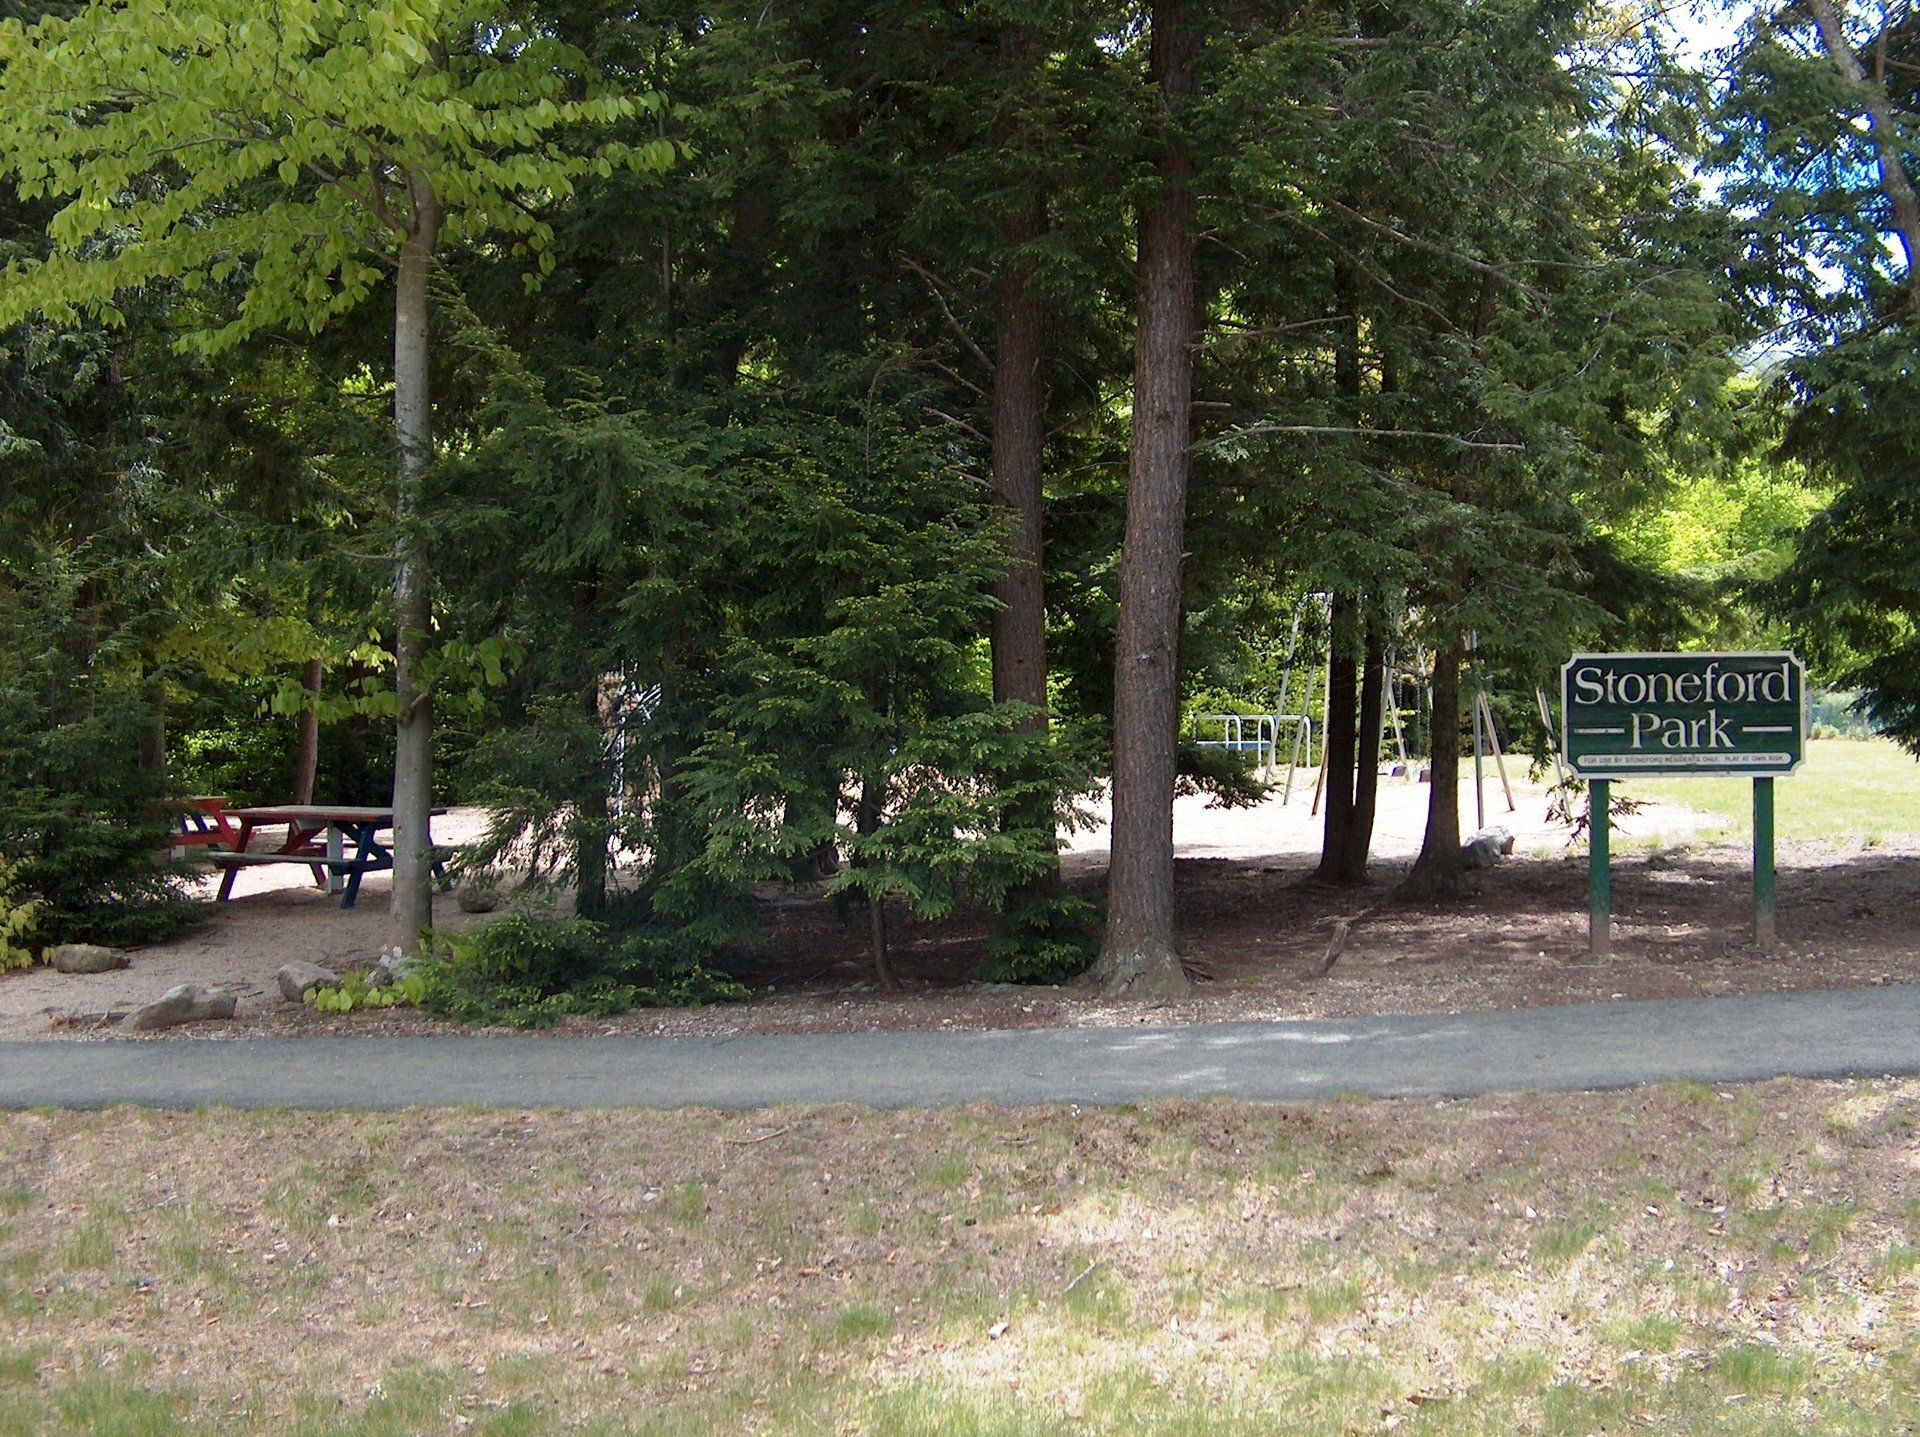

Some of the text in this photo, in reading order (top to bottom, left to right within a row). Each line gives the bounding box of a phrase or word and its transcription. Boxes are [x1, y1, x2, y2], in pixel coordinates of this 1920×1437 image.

[1574, 661, 1792, 704] Stoneford
[1630, 708, 1736, 749] Park
[1625, 756, 1664, 764] STONEFORD
